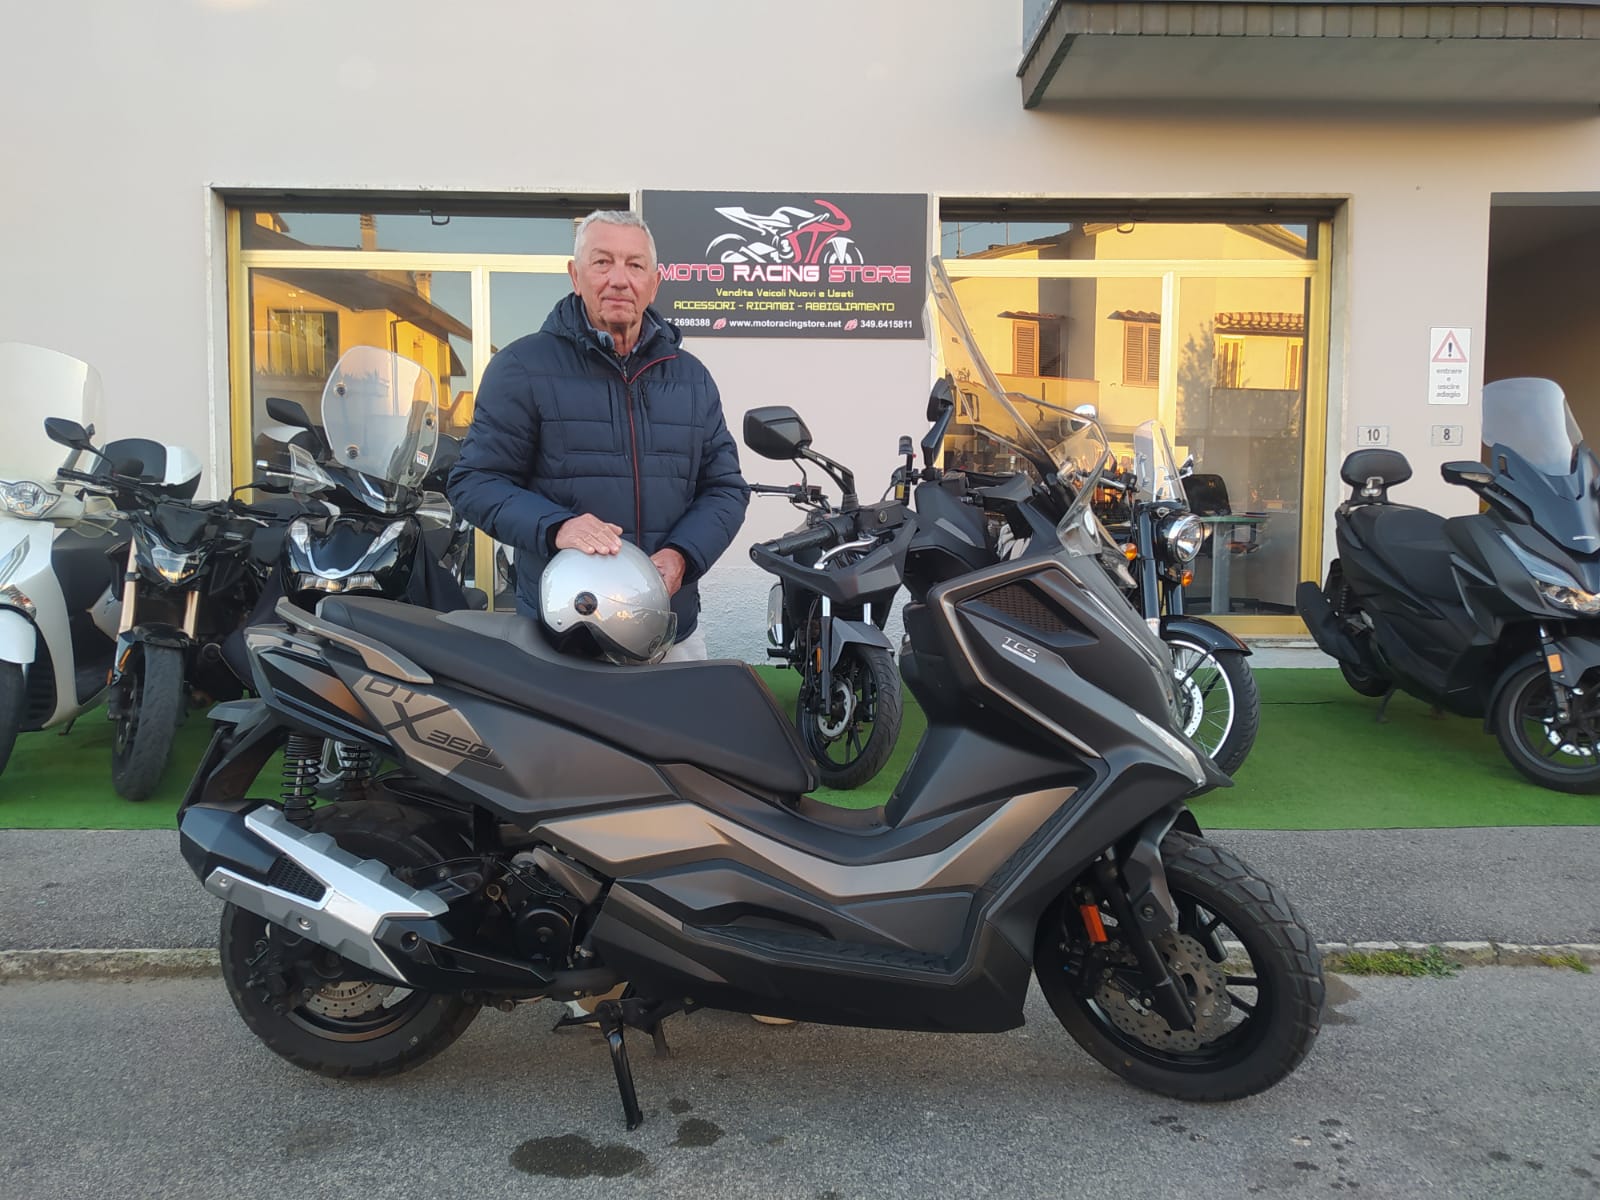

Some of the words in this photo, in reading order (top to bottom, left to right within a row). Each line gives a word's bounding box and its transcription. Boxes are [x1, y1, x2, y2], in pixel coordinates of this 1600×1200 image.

[658, 263, 724, 281] MOTO
[733, 264, 820, 282] RACING
[828, 265, 911, 283] STORE
[716, 288, 753, 297] Vendita
[756, 288, 786, 298] Veicoli
[788, 289, 816, 298] Nuovi
[828, 289, 854, 298] Usati
[674, 301, 736, 310] ACCESSORI
[746, 302, 794, 310] RICAMBI
[805, 302, 894, 312] ABBIGLIAMENTO
[730, 318, 842, 329] www.motoracingstore.net
[860, 320, 912, 328] 349.6415811
[1368, 428, 1380, 441] 10
[1444, 428, 1450, 440] 8
[1004, 636, 1040, 658] TCS
